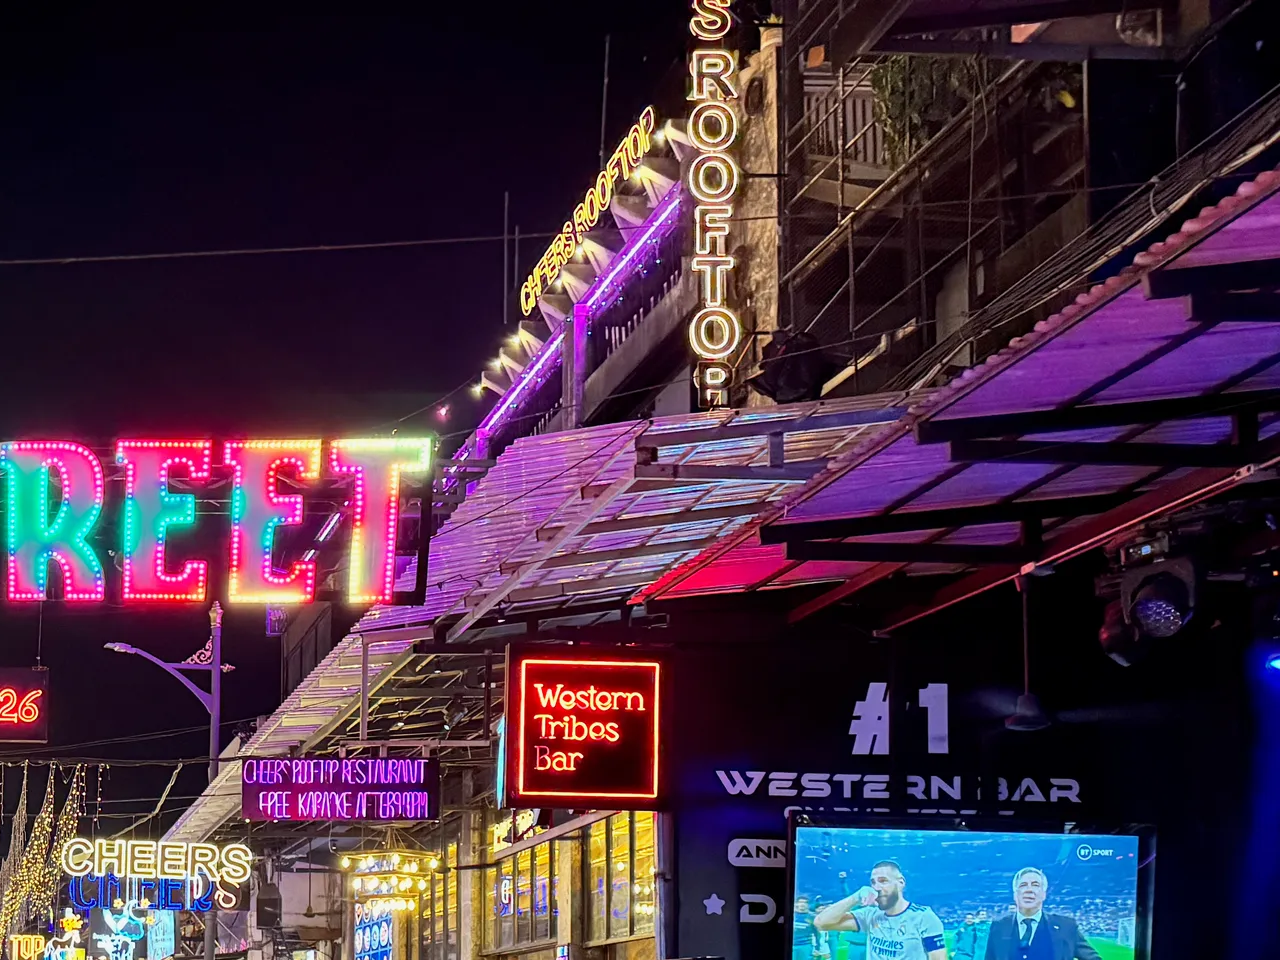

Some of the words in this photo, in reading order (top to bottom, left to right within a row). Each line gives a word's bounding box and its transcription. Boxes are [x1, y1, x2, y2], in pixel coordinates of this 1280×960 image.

[573, 105, 657, 243] ROOFTOP
[533, 683, 646, 711] Western
[533, 714, 620, 742] Tribes
[848, 681, 950, 755] #1
[533, 745, 584, 771] Bar
[715, 769, 961, 800] WESTERN
[997, 777, 1082, 803] BAR
[61, 837, 254, 883] CHEERS
[1092, 849, 1114, 857] SPORT
